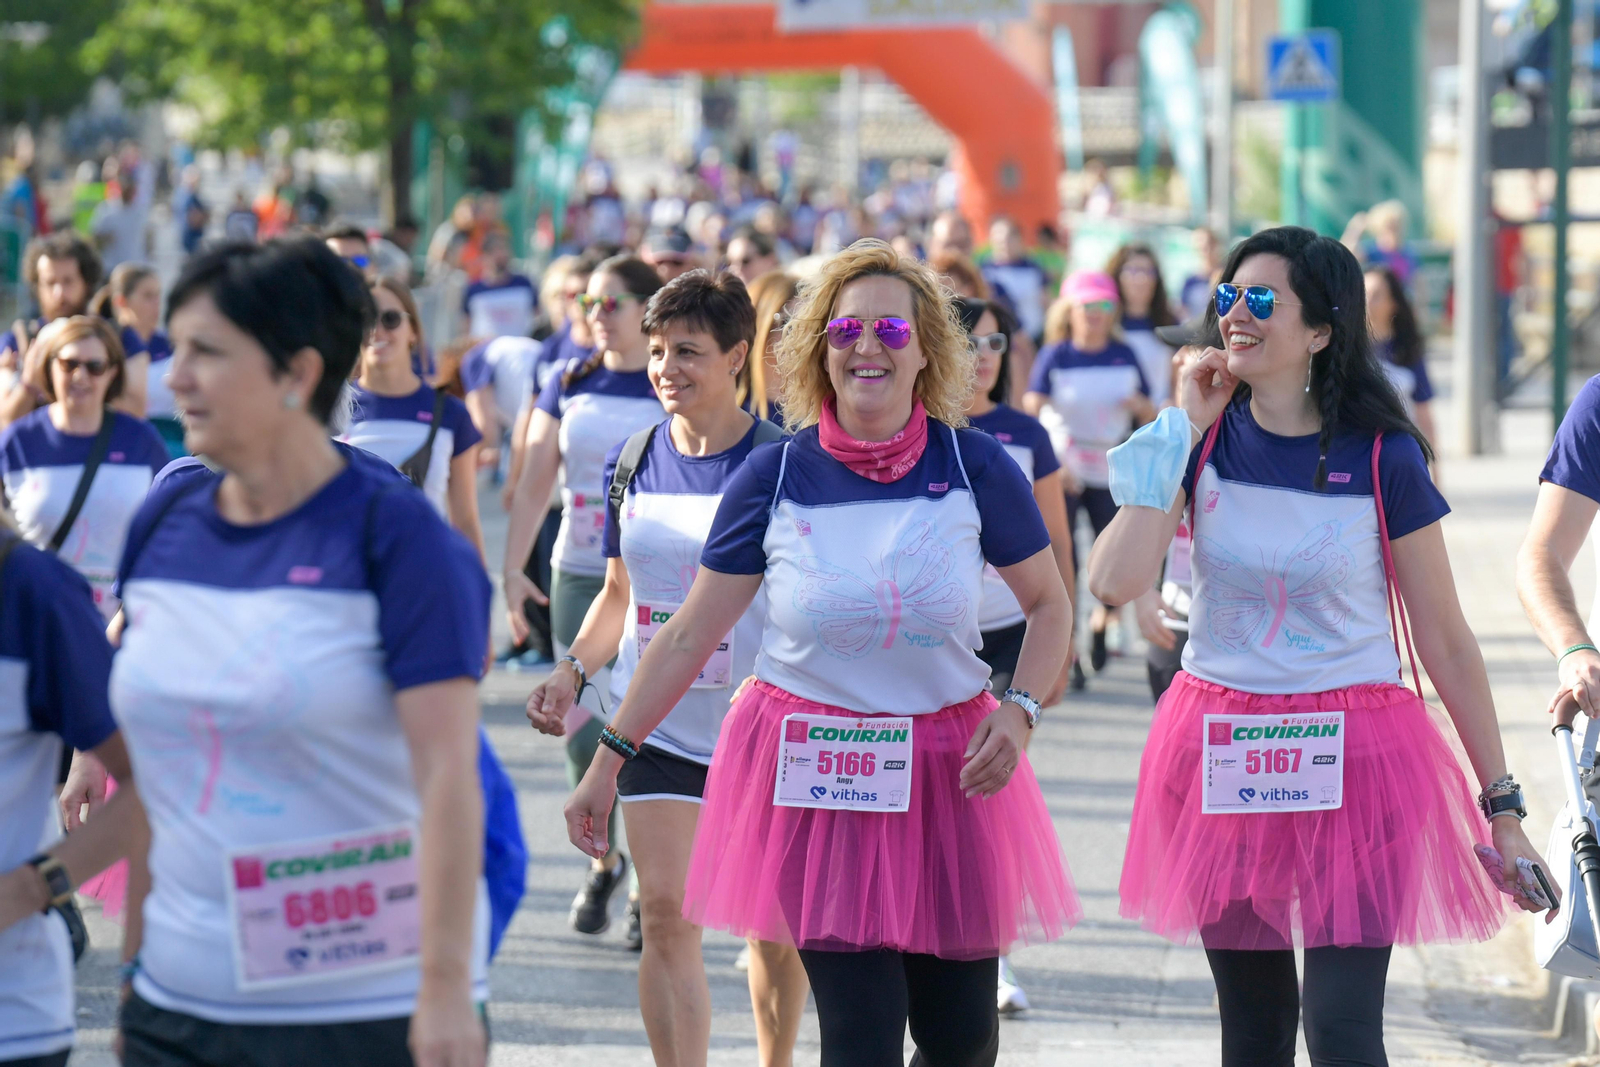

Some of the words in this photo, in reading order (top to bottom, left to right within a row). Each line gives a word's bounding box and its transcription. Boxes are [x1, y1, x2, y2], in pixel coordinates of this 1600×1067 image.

[1291, 717, 1340, 725] Fundación
[808, 727, 909, 743] COVIRAN
[1232, 724, 1339, 741] COVIRAN
[817, 750, 877, 777] 5166
[1245, 748, 1303, 775] 5167
[836, 776, 853, 785] Angy
[831, 788, 878, 802] vithas
[1260, 788, 1309, 801] vithas
[284, 882, 378, 928] 6806
